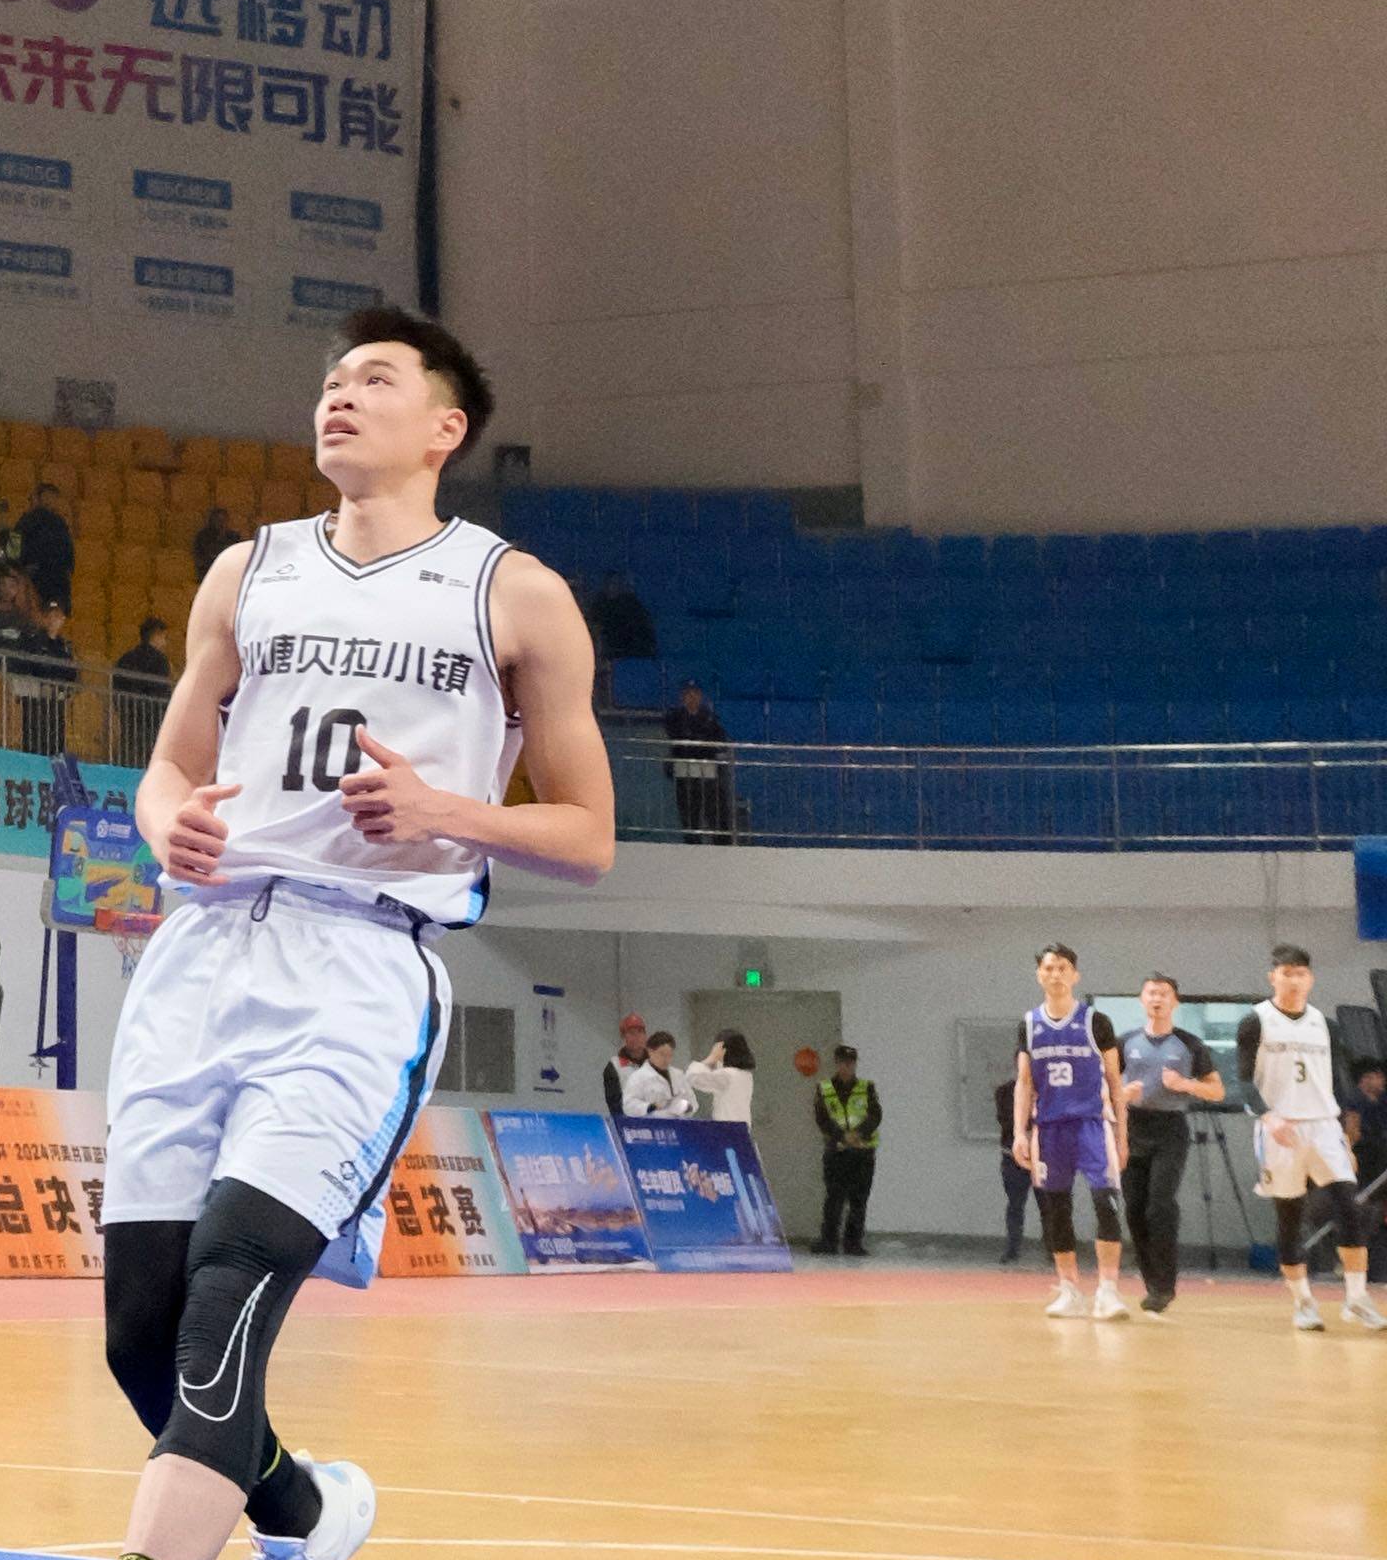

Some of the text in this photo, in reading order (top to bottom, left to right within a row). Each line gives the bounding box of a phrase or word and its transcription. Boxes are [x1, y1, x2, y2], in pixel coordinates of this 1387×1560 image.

[281, 706, 368, 793] 10
[1047, 1062, 1073, 1087] 23
[1294, 1061, 1308, 1083] 3
